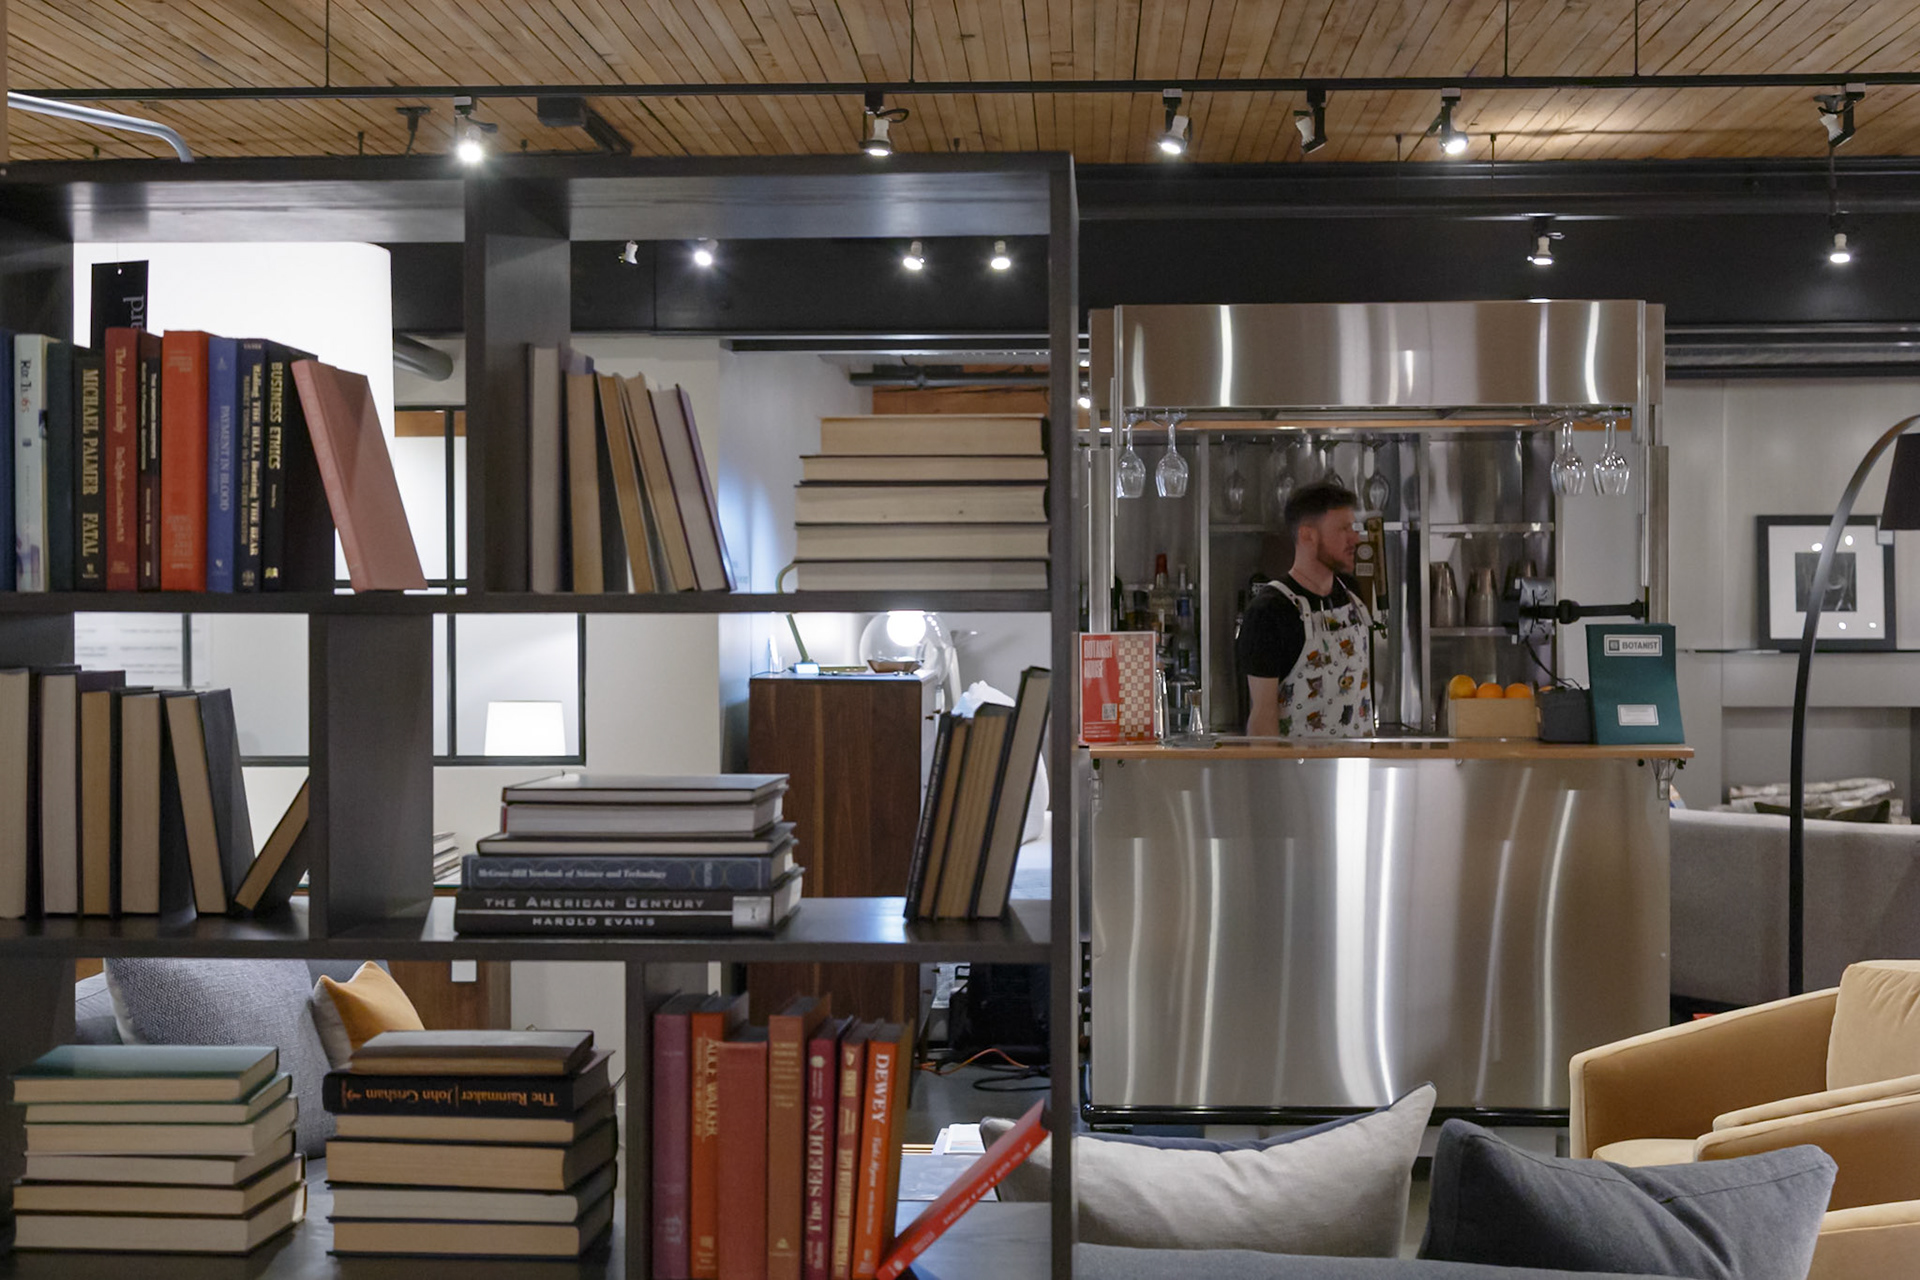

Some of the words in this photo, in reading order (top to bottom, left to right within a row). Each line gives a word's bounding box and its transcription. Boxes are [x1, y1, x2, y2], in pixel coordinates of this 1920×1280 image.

[251, 364, 262, 398] Riding
[270, 362, 283, 423] BUSINESS
[82, 369, 99, 434] MICHAEL
[251, 400, 261, 423] THE
[220, 405, 231, 456] PAYMENT
[251, 426, 260, 458] BULL,
[268, 426, 282, 469] ETHICS
[82, 437, 99, 495] PALMER
[220, 458, 230, 471] IN
[249, 460, 260, 499] Beating
[219, 472, 230, 511] BLOOD
[250, 501, 259, 525] THE
[82, 512, 99, 557] FATAL
[249, 526, 259, 556] BEAR
[1621, 641, 1659, 650] BOTANIST
[565, 868, 575, 879] of
[576, 868, 604, 880] Science
[605, 868, 622, 880] and
[623, 868, 667, 881] Technology
[484, 898, 516, 908] THE
[526, 896, 616, 909] AMERICAN
[625, 897, 705, 909] CENTURY
[532, 917, 596, 927] HAROLD
[604, 917, 655, 927] EVANS
[365, 1087, 418, 1104] Grisham
[422, 1088, 453, 1104] John
[461, 1090, 527, 1107] Rainmaker
[531, 1091, 558, 1107] The
[871, 1053, 891, 1125] DEWEY
[807, 1104, 826, 1197] SEEDING
[807, 1201, 823, 1234] The
